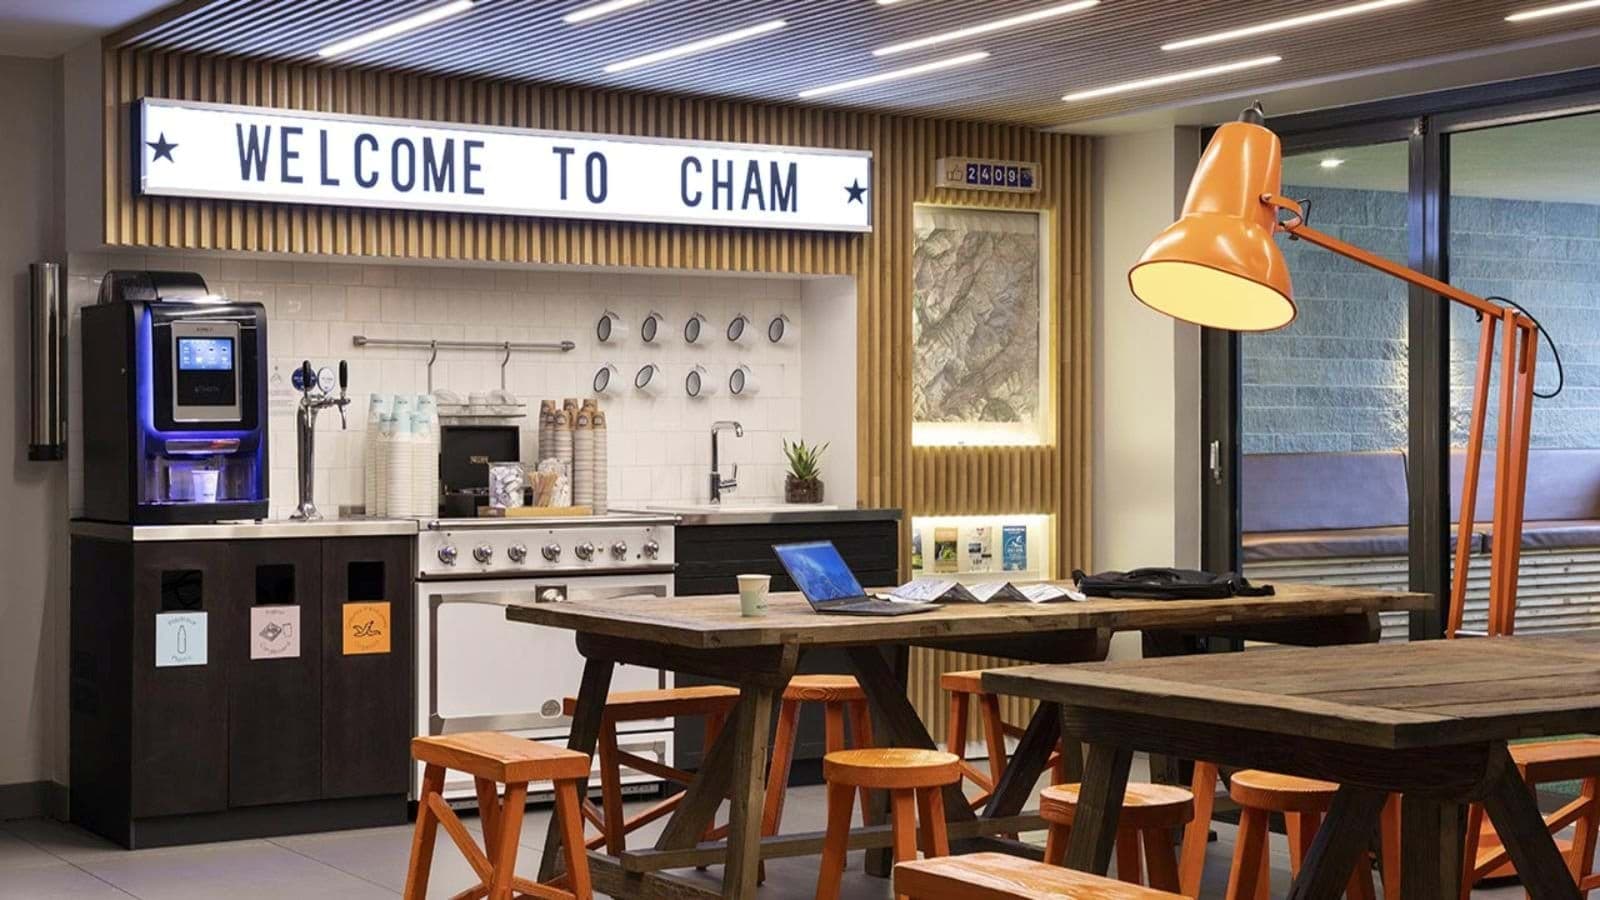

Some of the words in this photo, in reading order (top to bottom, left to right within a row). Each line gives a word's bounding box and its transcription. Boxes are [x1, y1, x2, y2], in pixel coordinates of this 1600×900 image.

[236, 123, 485, 195] WELCOME
[552, 147, 607, 204] TO
[681, 156, 797, 213] CHAM
[968, 168, 1028, 184] 2409
